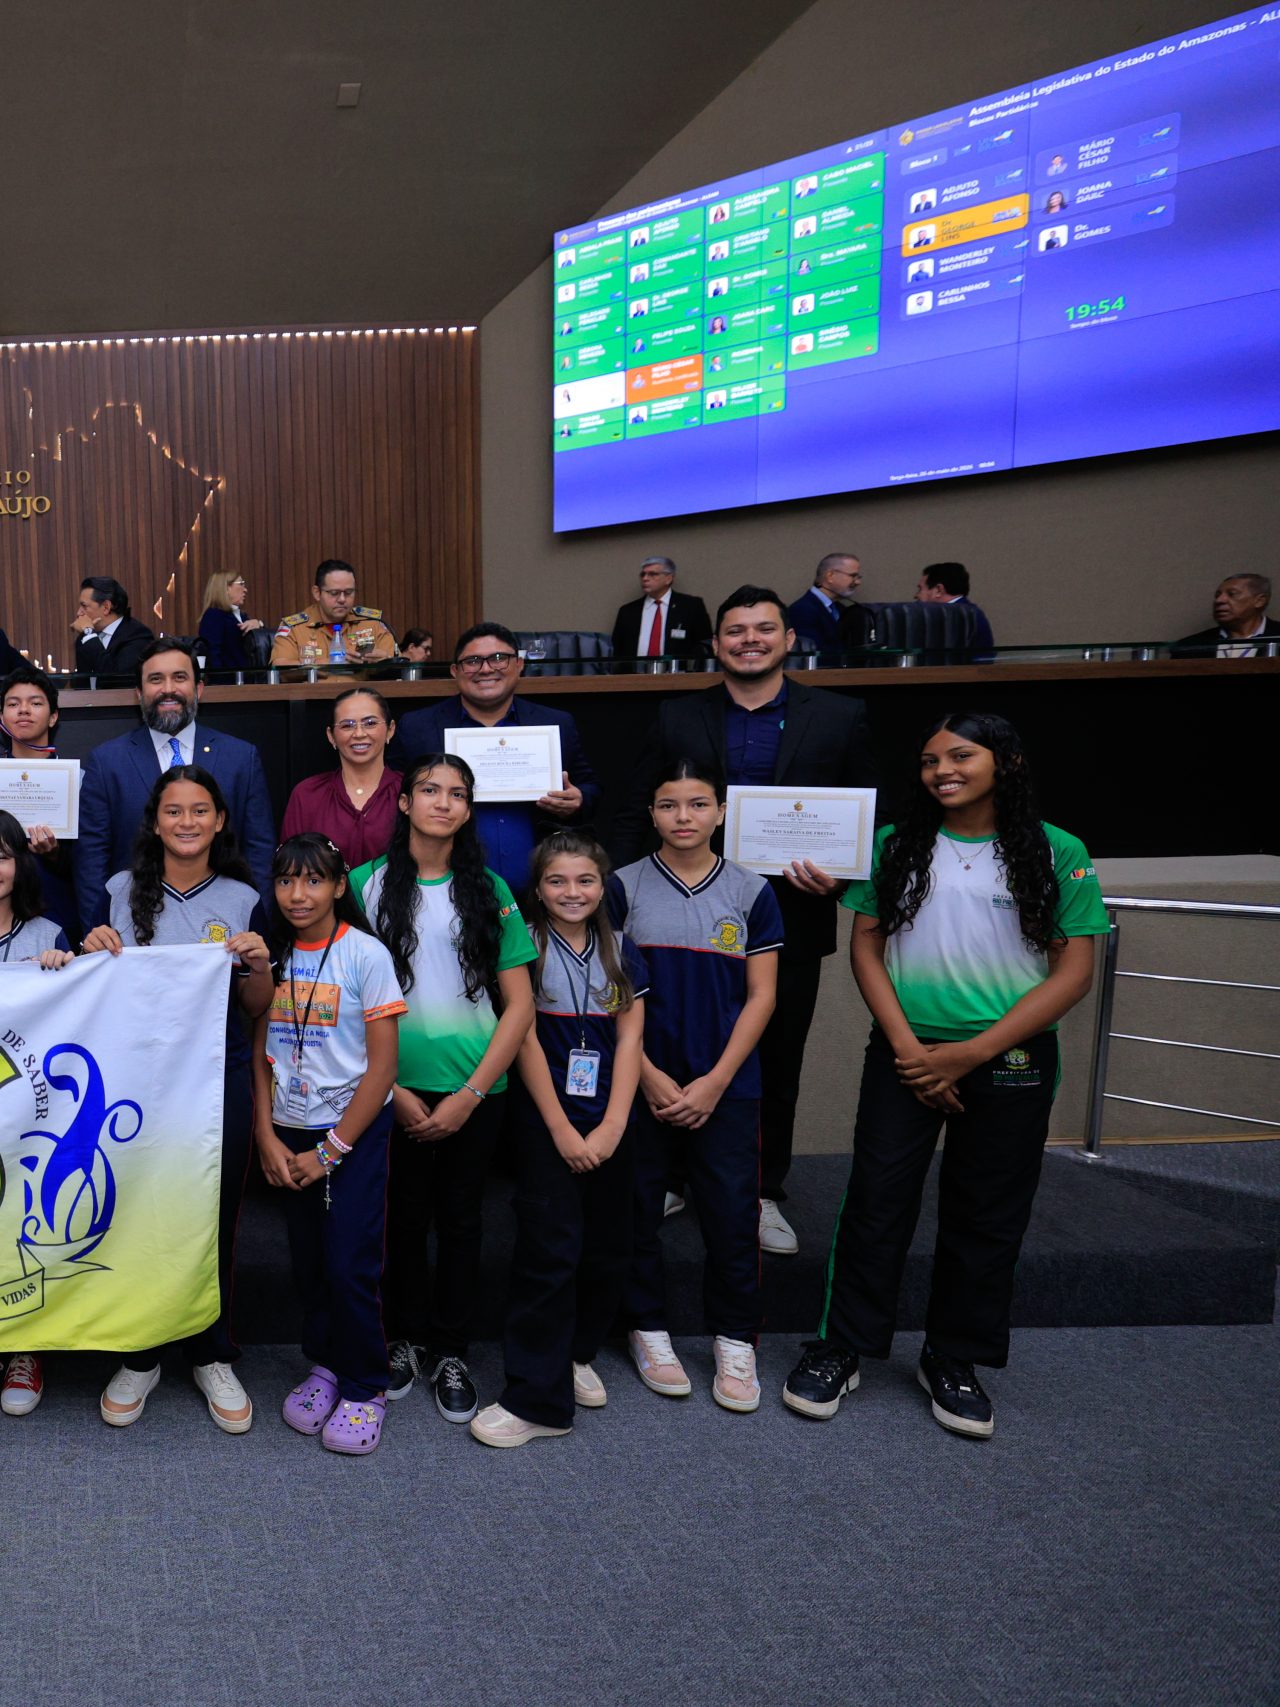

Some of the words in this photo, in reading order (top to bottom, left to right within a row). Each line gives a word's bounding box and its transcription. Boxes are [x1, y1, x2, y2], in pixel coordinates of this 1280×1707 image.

[968, 91, 1031, 118] Assembleia
[1032, 71, 1093, 97] Legislativa
[1095, 65, 1111, 78] do
[1114, 50, 1155, 71] Estado
[1157, 44, 1175, 57] do
[1178, 22, 1247, 51] Amazonas
[968, 116, 995, 128] Blocos
[1079, 136, 1115, 153] MÁRIO
[1078, 146, 1111, 162] CÉSAR
[1078, 155, 1109, 170] FILHO
[941, 187, 980, 203] AFONSO
[942, 180, 980, 196] ADJUTO
[1076, 180, 1112, 198] JOANA
[1076, 190, 1106, 204] DARC
[1074, 223, 1089, 233] Dr.
[1074, 225, 1112, 241] GOMES
[939, 246, 996, 266] WANDERLEY
[939, 256, 989, 274] MONTEIRO
[937, 281, 991, 299] CARLINHOS
[937, 294, 967, 307] BESSA
[1065, 295, 1126, 322] 19:54
[1, 1029, 26, 1054] DE
[22, 1053, 50, 1121] SABER
[1, 1281, 38, 1312] VIDAS
